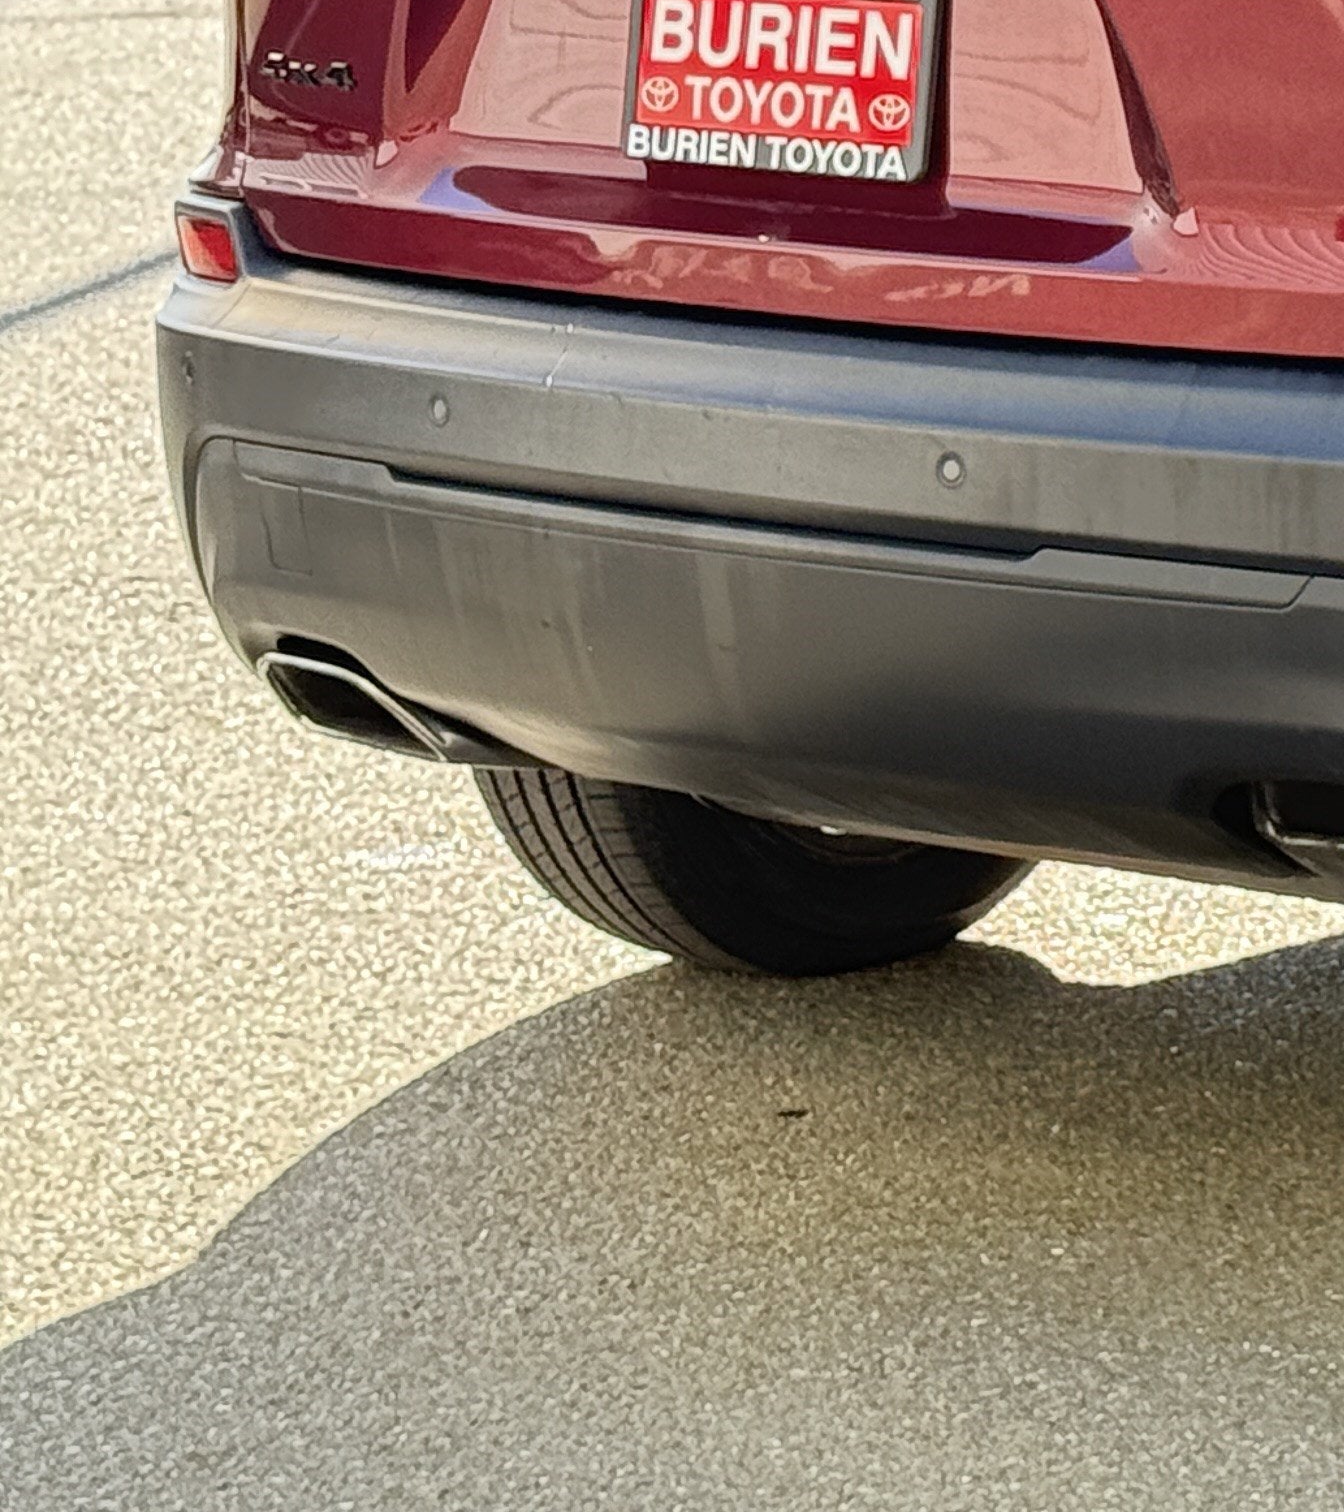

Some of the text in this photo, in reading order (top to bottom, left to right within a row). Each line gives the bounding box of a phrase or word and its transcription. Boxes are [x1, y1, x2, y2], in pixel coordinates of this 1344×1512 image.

[684, 75, 861, 133] TOYOTA
[626, 123, 907, 181] BURIEN TOYOTA
